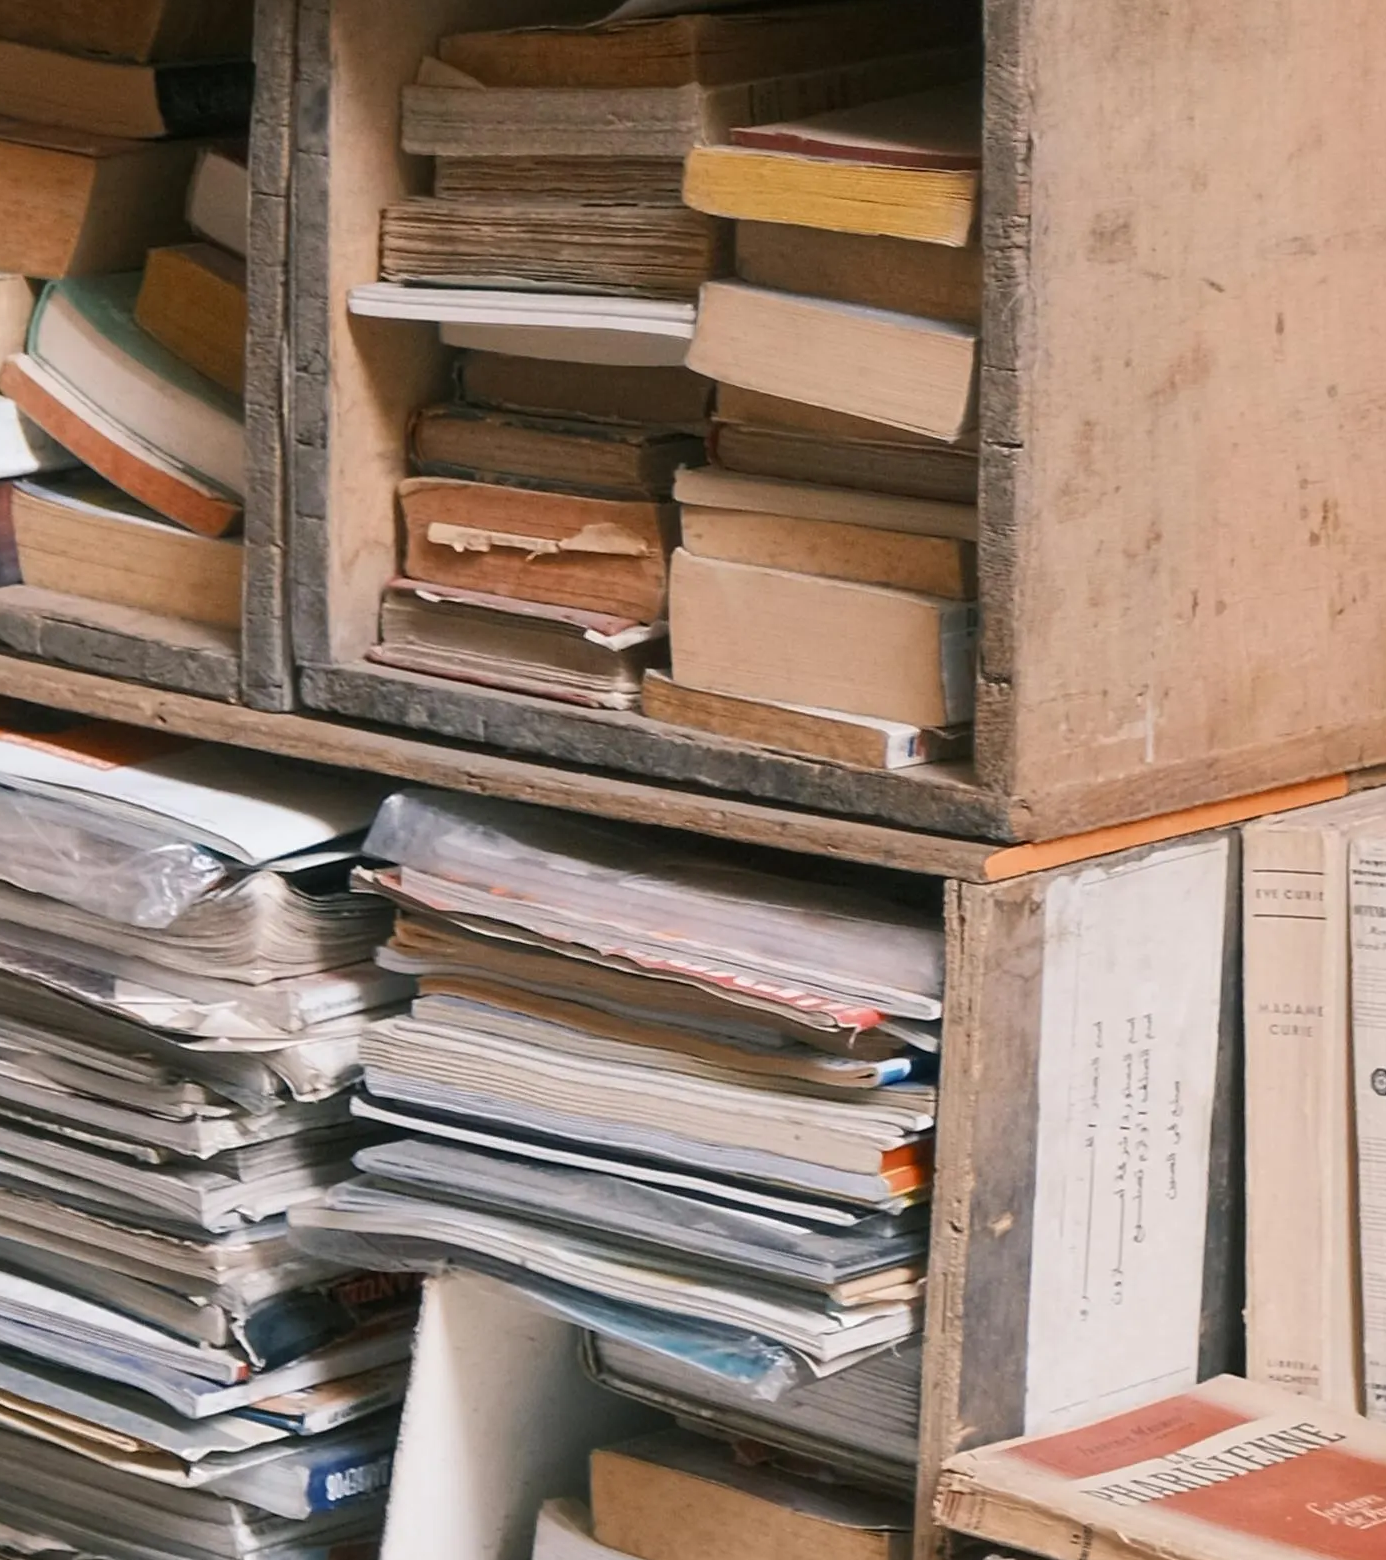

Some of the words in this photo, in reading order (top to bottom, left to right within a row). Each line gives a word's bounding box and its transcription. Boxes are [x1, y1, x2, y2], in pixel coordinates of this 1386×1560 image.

[1284, 889, 1325, 901] CURIE
[1257, 1003, 1325, 1016] MADAME
[1269, 1024, 1314, 1037] CURIE
[1078, 1421, 1348, 1508] PHARISIENNE
